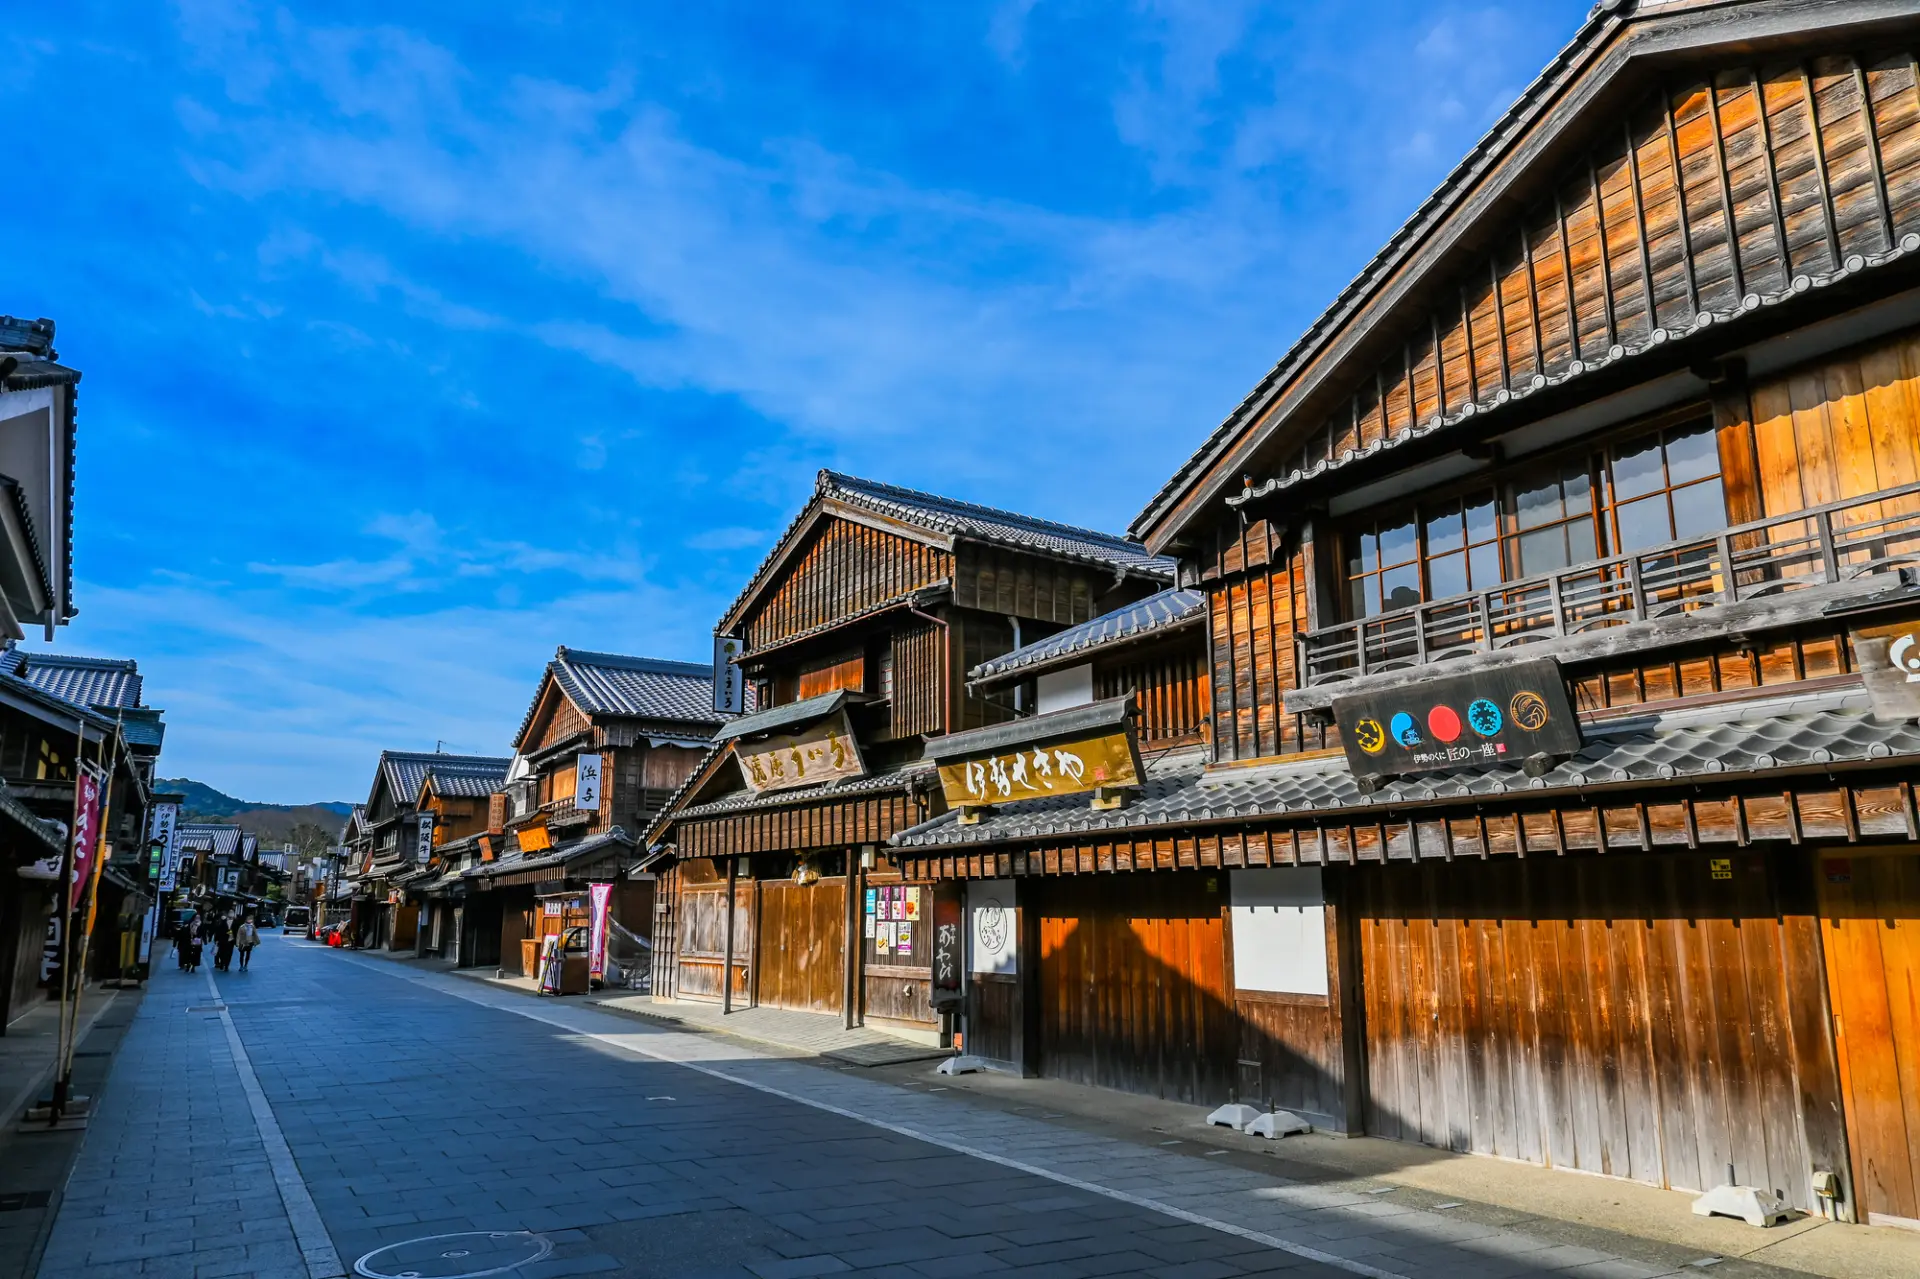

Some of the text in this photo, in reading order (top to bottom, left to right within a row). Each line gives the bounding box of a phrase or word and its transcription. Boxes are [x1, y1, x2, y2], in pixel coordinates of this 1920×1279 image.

[1413, 752, 1447, 764] 伊勢のくに
[1446, 743, 1497, 762] 匠の一座
[581, 765, 597, 802] 浜与
[965, 745, 1084, 801] 伊勢せきや
[420, 820, 431, 854] 松阪牛
[936, 924, 953, 980] あわび
